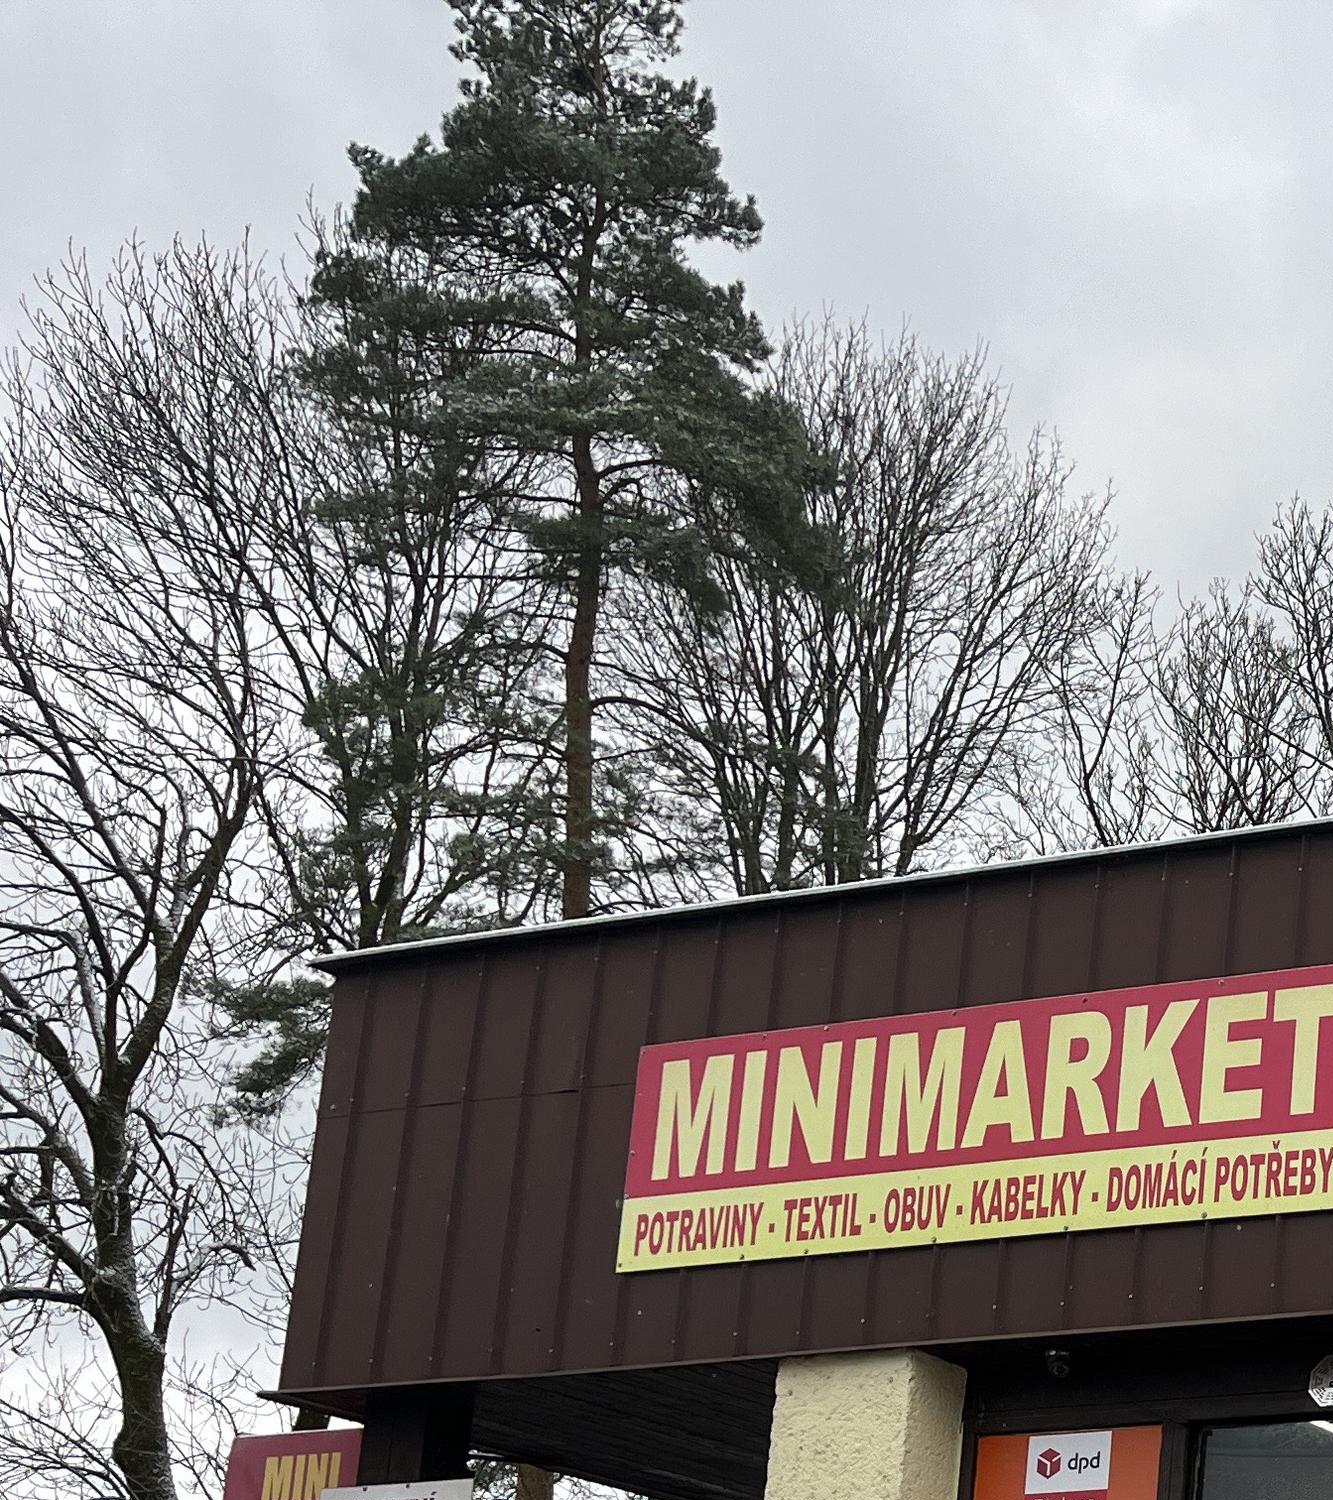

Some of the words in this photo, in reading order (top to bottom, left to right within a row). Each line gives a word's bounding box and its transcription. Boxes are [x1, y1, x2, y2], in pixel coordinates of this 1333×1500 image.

[634, 1202, 762, 1256] POTRAVINY
[783, 1192, 862, 1243] TEXTIL
[883, 1184, 952, 1234] OBUV
[970, 1169, 1087, 1225] KABELKY
[1107, 1146, 1208, 1213] DOMÁCÍ
[1067, 1450, 1101, 1474] dpd
